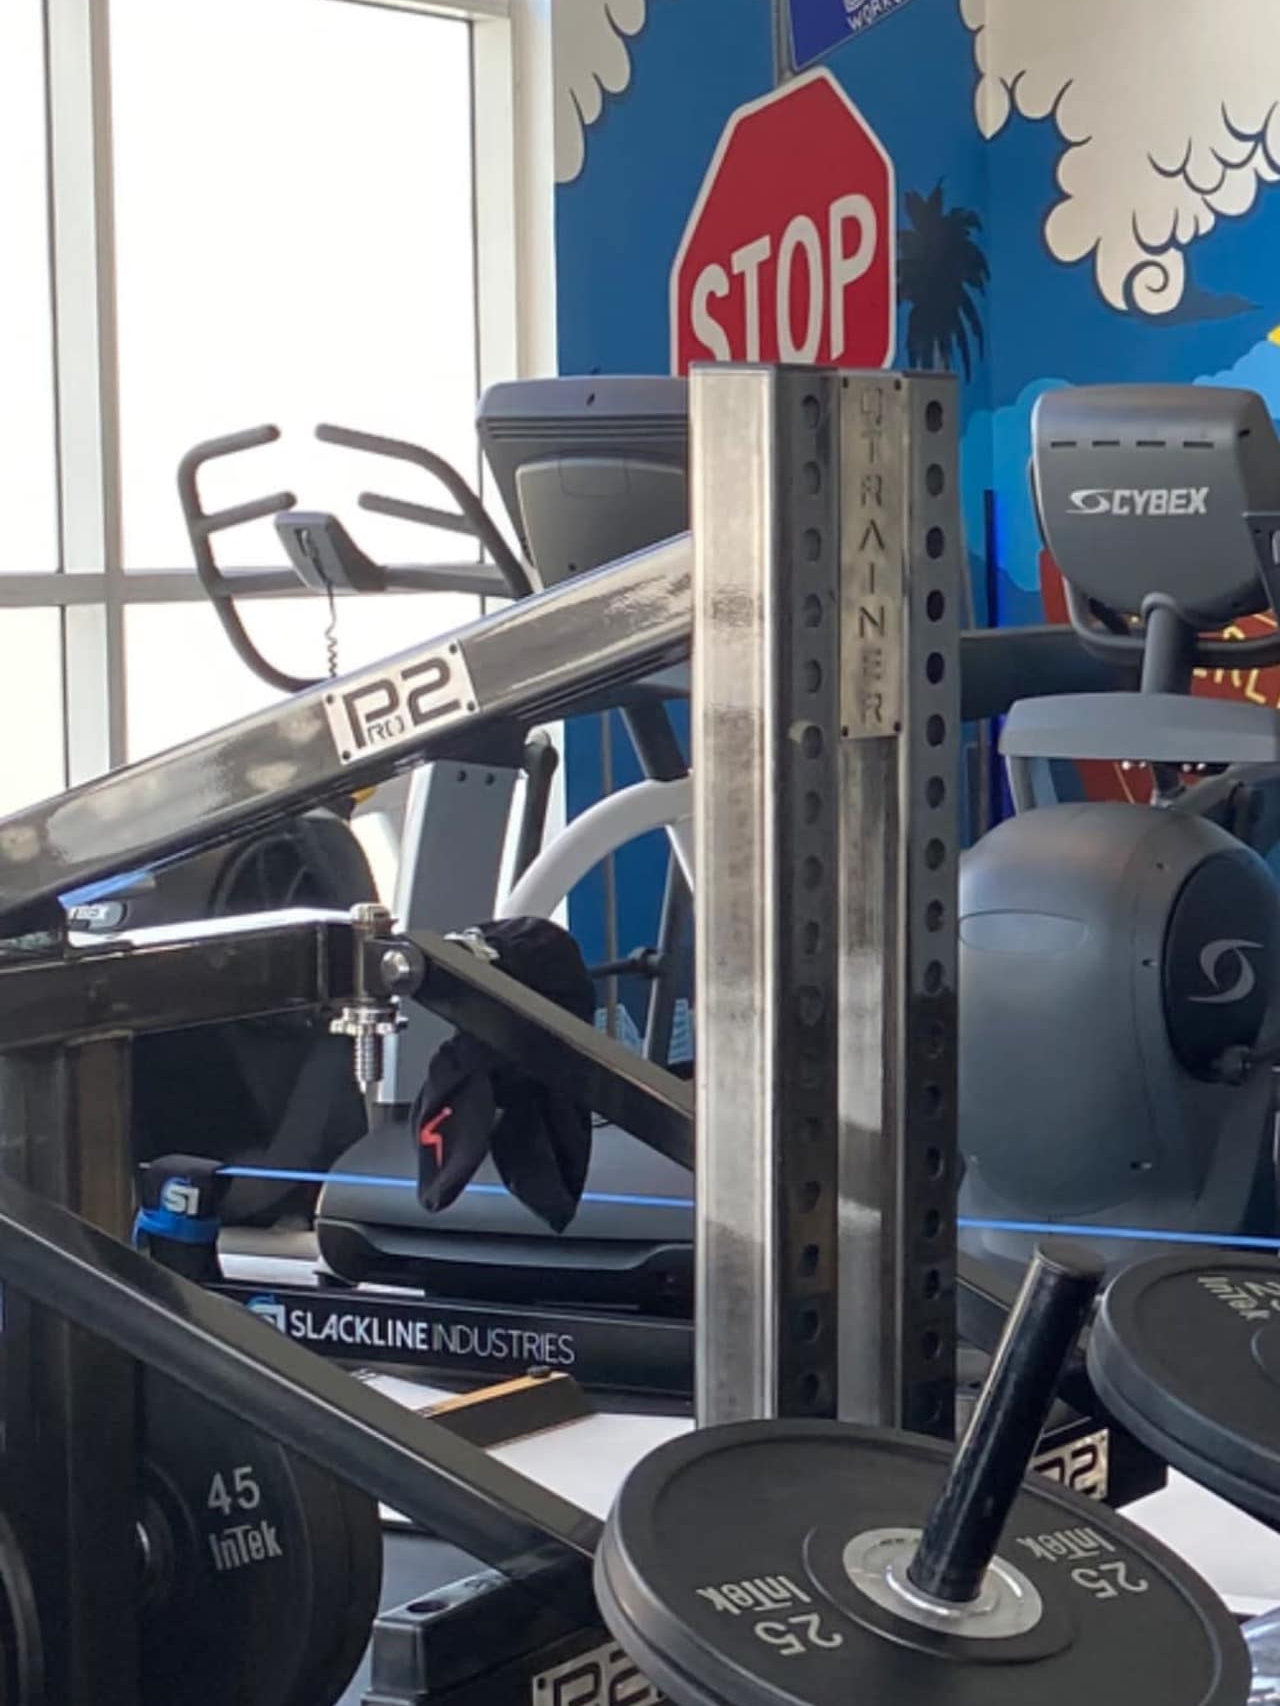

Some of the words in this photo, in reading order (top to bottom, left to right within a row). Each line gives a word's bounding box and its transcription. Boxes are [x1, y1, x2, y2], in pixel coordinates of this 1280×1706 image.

[690, 192, 878, 366] STOP
[1111, 487, 1209, 516] CYBEX
[1196, 1275, 1270, 1323] InTek
[289, 1309, 430, 1351] SLACKLINE
[431, 1322, 576, 1365] INDUSTRIES
[206, 1465, 262, 1517] 45
[208, 1518, 284, 1572] InTek
[1016, 1525, 1117, 1561] InTek
[696, 1573, 811, 1617] InTek
[1070, 1565, 1150, 1600] 25
[754, 1612, 845, 1658] 25
